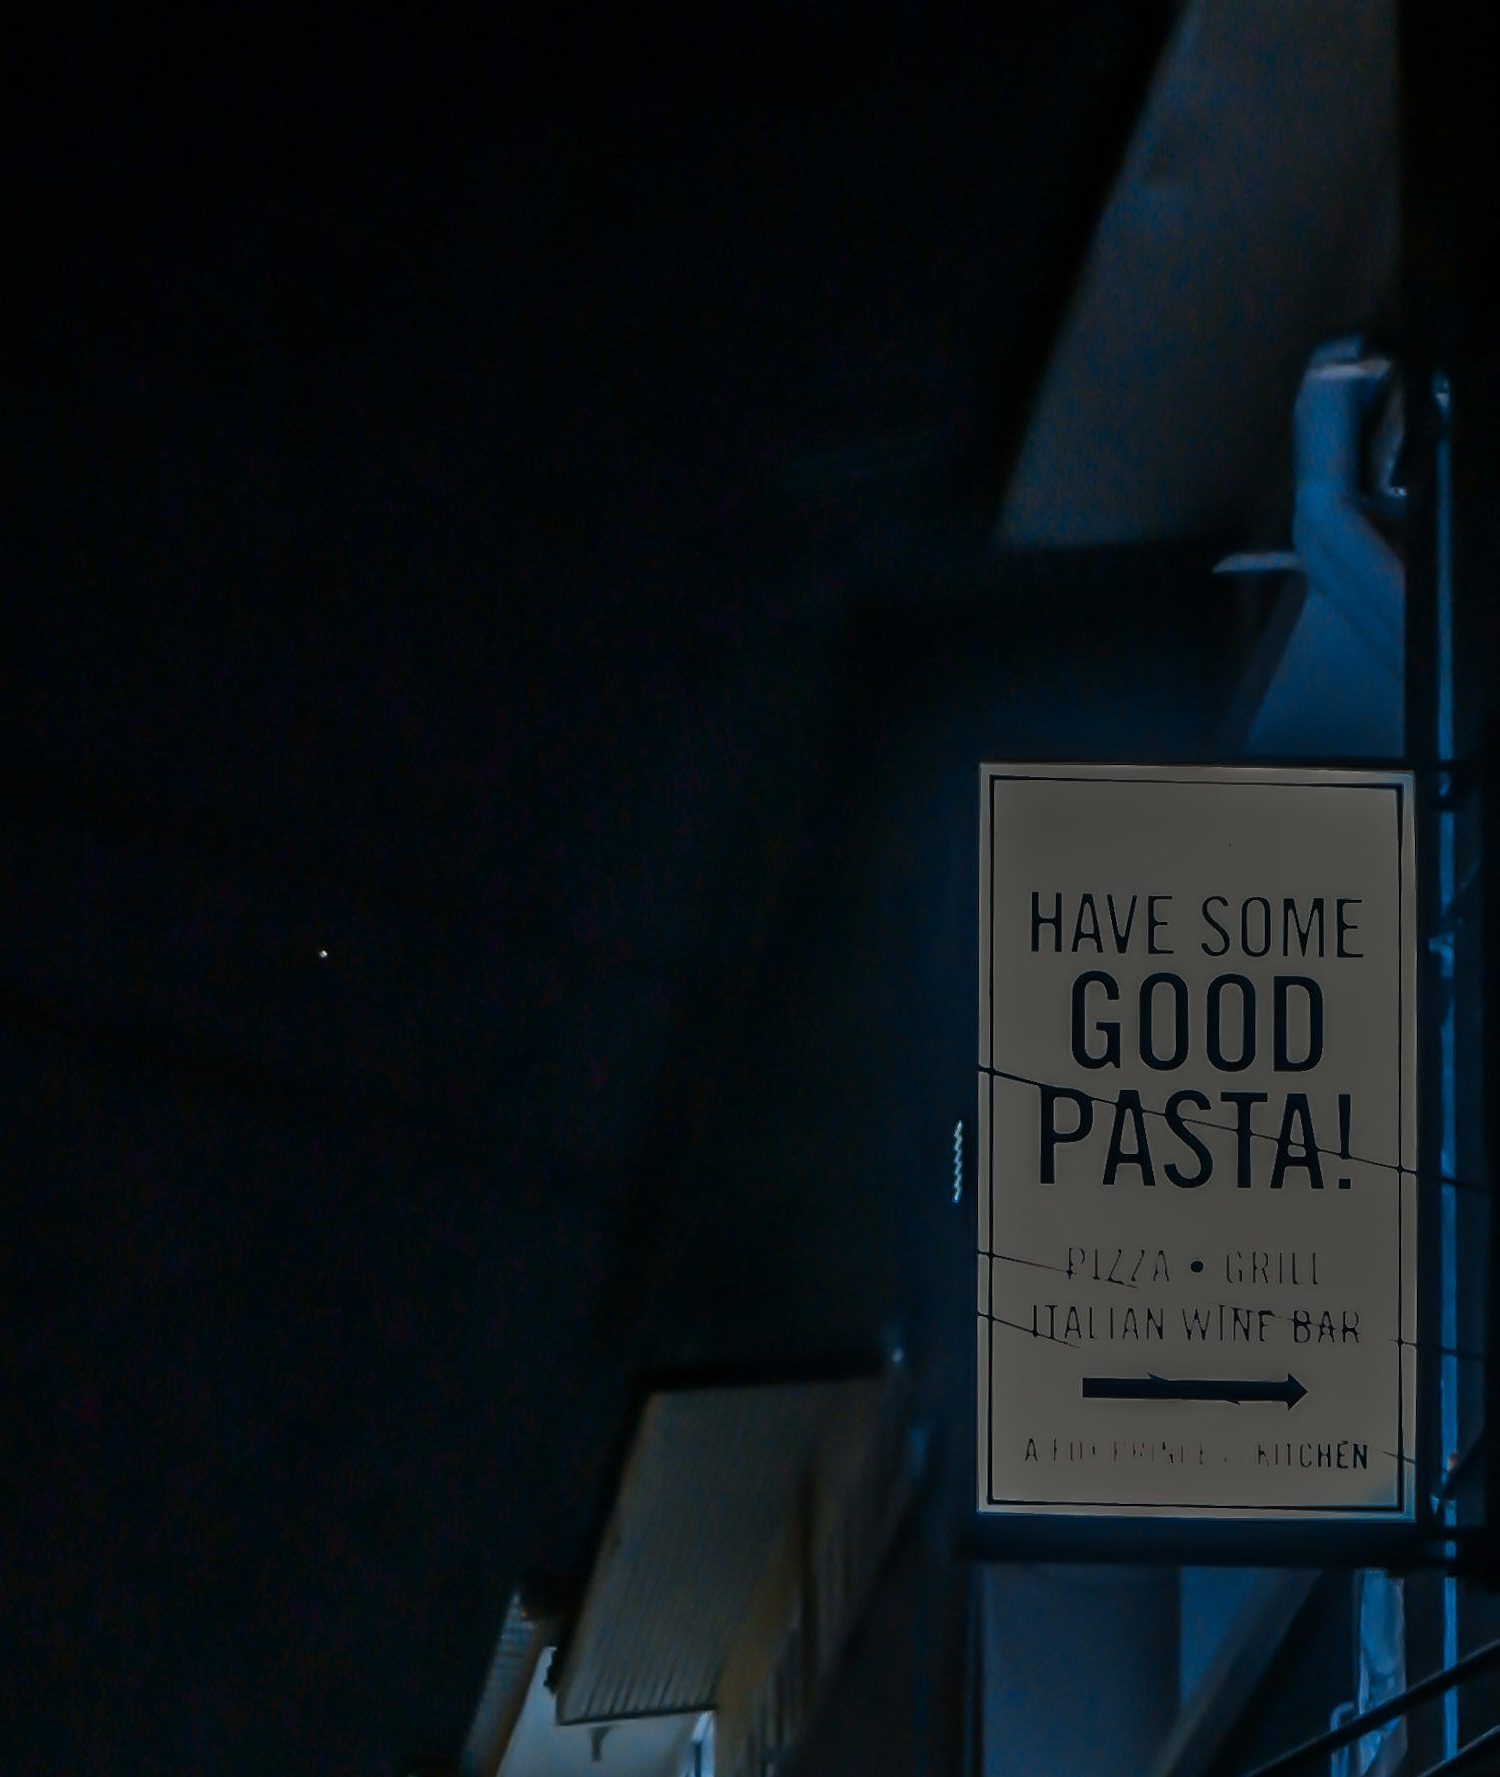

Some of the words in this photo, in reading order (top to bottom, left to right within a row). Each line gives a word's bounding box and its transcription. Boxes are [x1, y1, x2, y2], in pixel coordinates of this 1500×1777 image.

[1031, 891, 1174, 955] HAVE
[1200, 895, 1364, 959] SOME
[1070, 970, 1324, 1073] GOOD
[1040, 1087, 1352, 1190] PASTA!
[1066, 1247, 1170, 1286] PIZZA
[1032, 1304, 1165, 1341] ITALIAN
[1292, 1309, 1360, 1344] BAR
